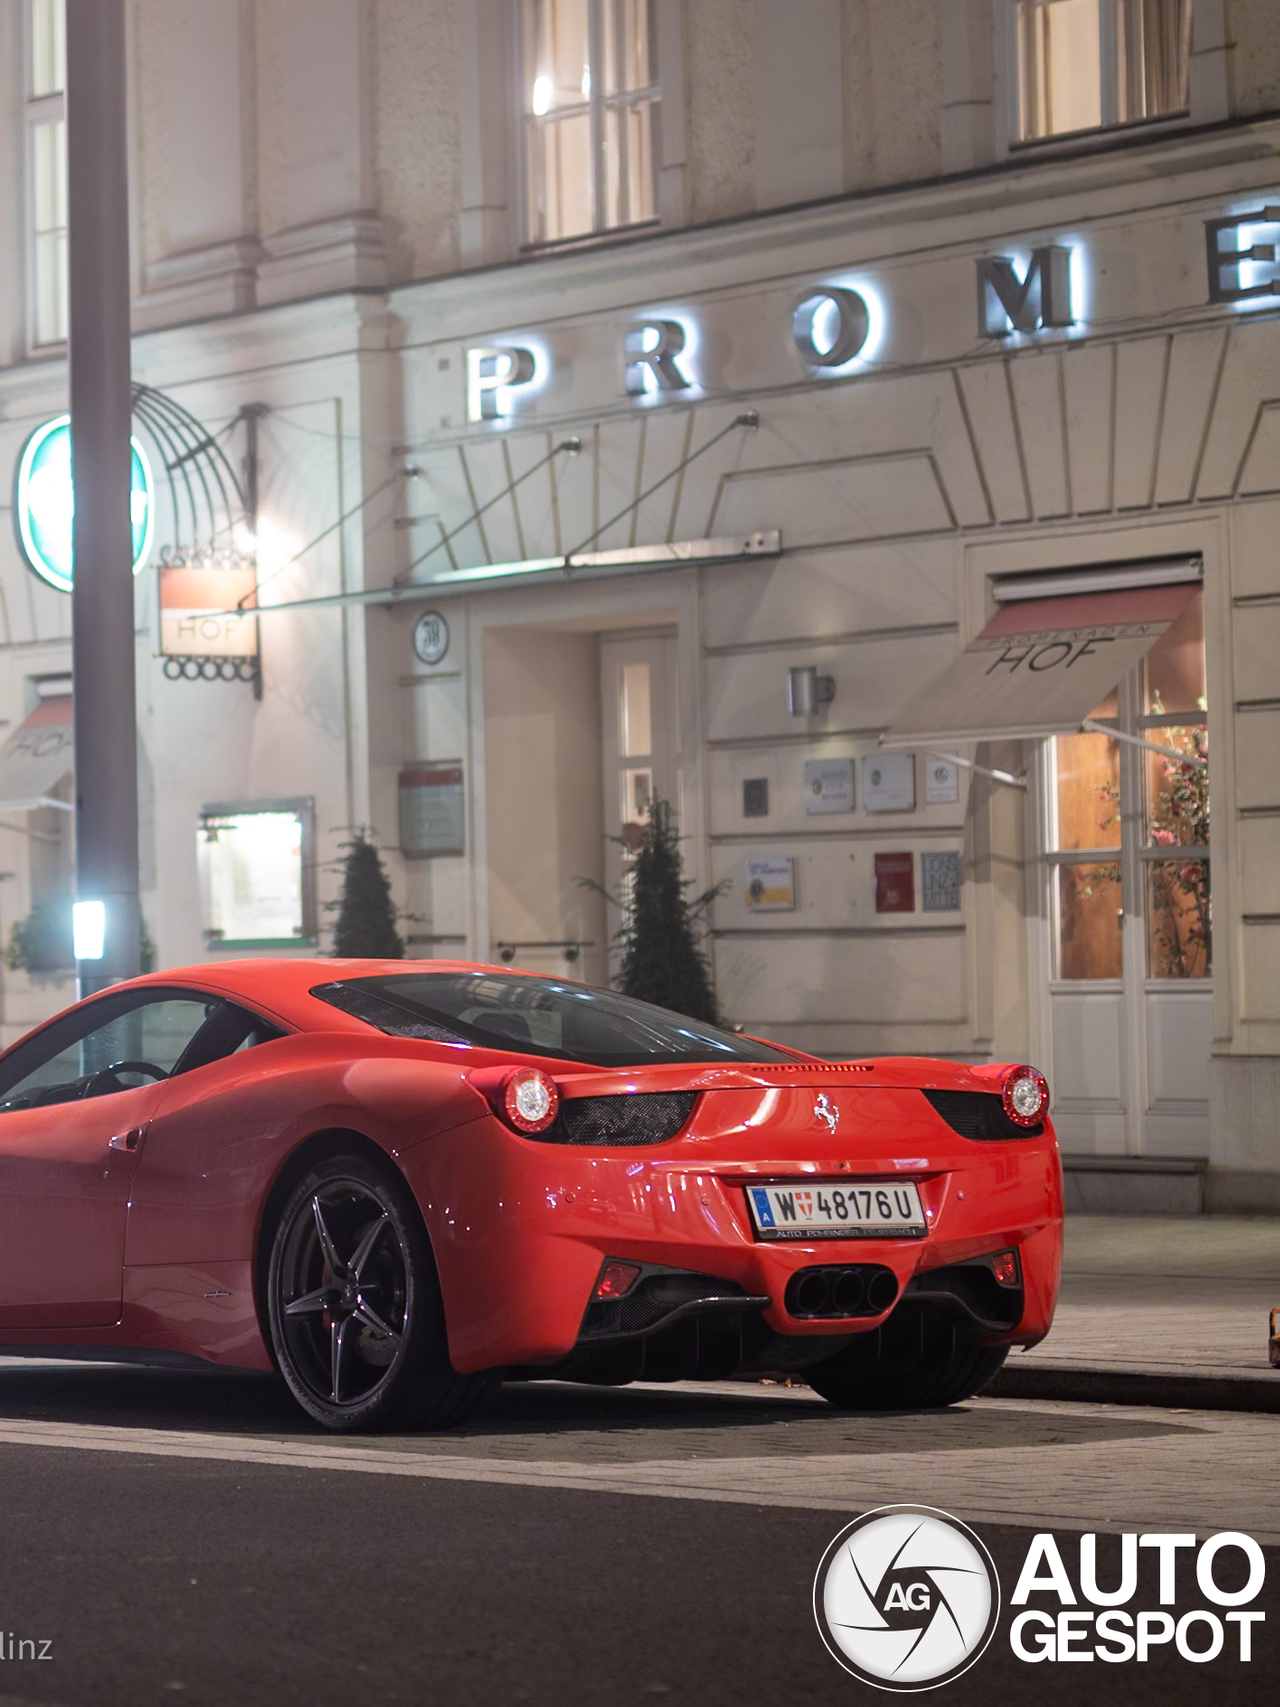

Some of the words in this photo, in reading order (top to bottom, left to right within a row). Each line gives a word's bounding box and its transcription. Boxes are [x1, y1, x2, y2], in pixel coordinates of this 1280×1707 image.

[466, 205, 1280, 421] PROME
[177, 618, 239, 640] HOF
[985, 637, 1116, 676] HOF
[762, 1212, 771, 1222] A
[774, 1192, 797, 1222] W
[816, 1190, 912, 1220] 48176U
[776, 1230, 802, 1238] AUTO
